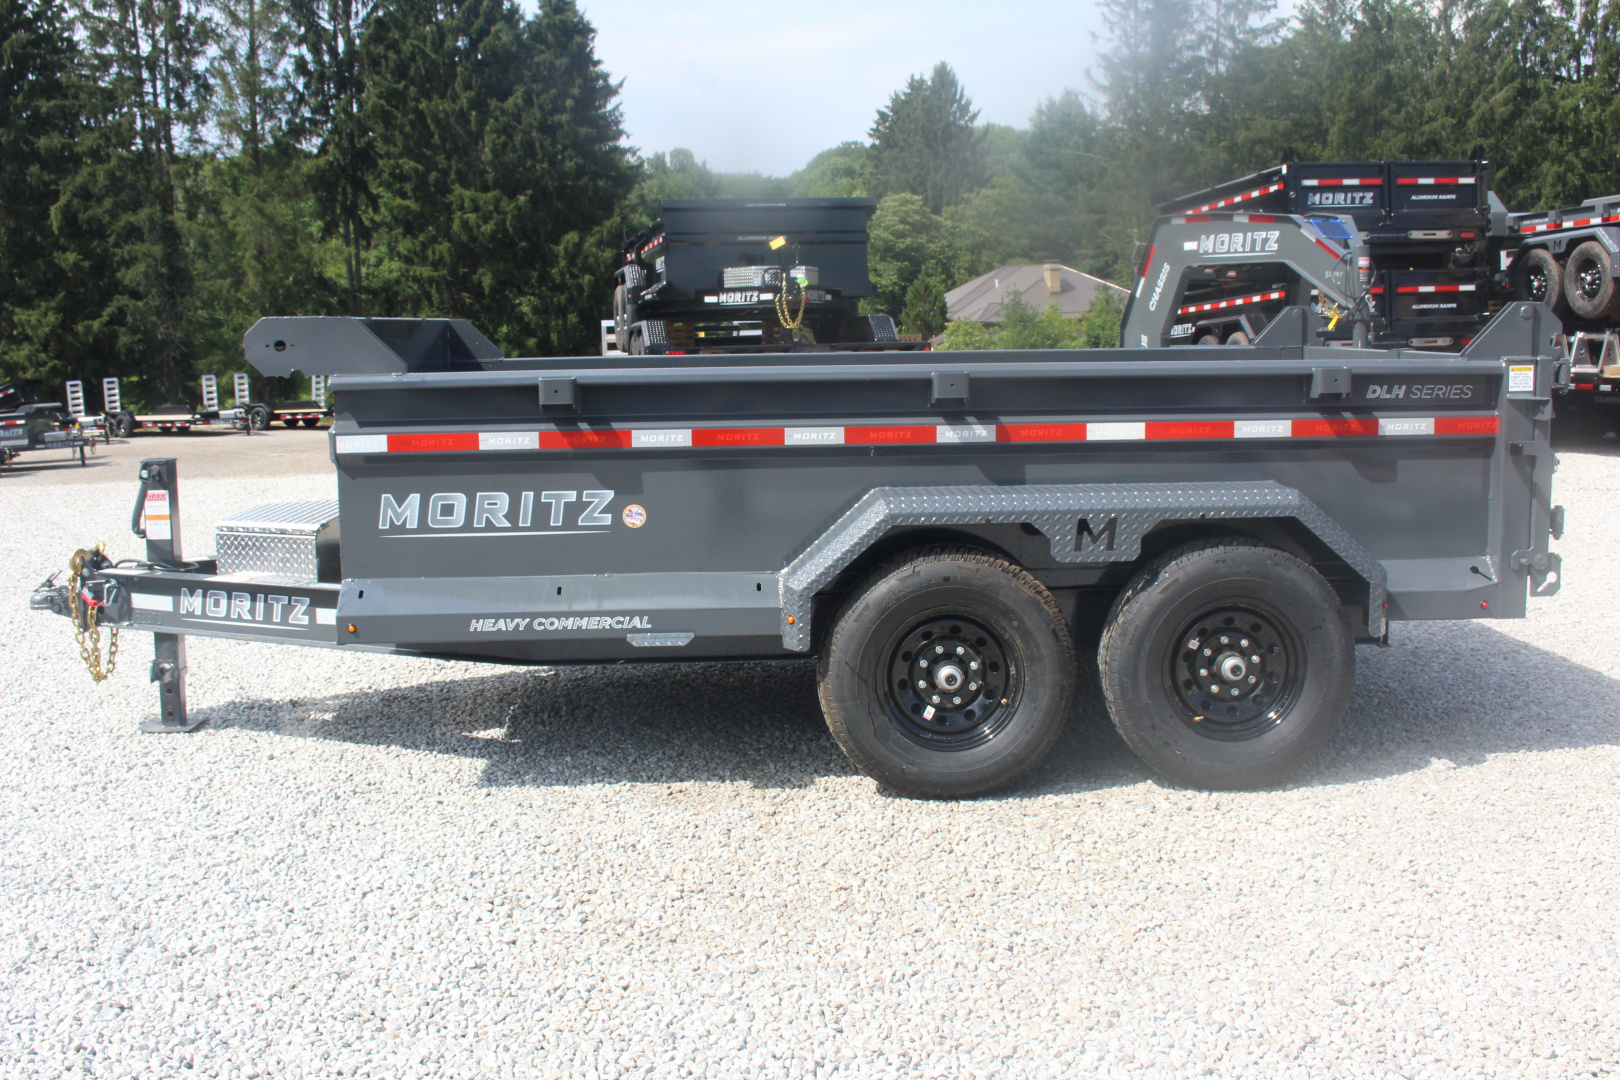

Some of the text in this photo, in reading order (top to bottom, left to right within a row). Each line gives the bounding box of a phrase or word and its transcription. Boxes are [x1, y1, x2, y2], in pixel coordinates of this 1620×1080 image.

[1307, 192, 1374, 205] MORITZ
[1199, 231, 1280, 253] MORITZ
[719, 291, 759, 303] MORITZ
[1148, 262, 1171, 312] CHASSIS
[1366, 384, 1473, 399] DLH SERIES
[488, 436, 531, 445] MORITZ
[640, 433, 684, 442] MORITZ
[717, 432, 760, 441] MORITZ
[793, 431, 836, 440] MORITZ
[869, 431, 912, 440] MORITZ
[945, 429, 988, 438] MORITZ
[1020, 428, 1063, 437] MORITZ
[1242, 424, 1284, 433] MORITZ
[1386, 422, 1426, 431] MORITZ
[1457, 421, 1498, 430] MORITZ
[147, 493, 167, 501] RAM
[378, 490, 615, 529] MORITZ
[1074, 517, 1118, 551] M
[179, 588, 310, 625] MORITZ
[470, 616, 652, 632] HEAVY COMMERCIAL
